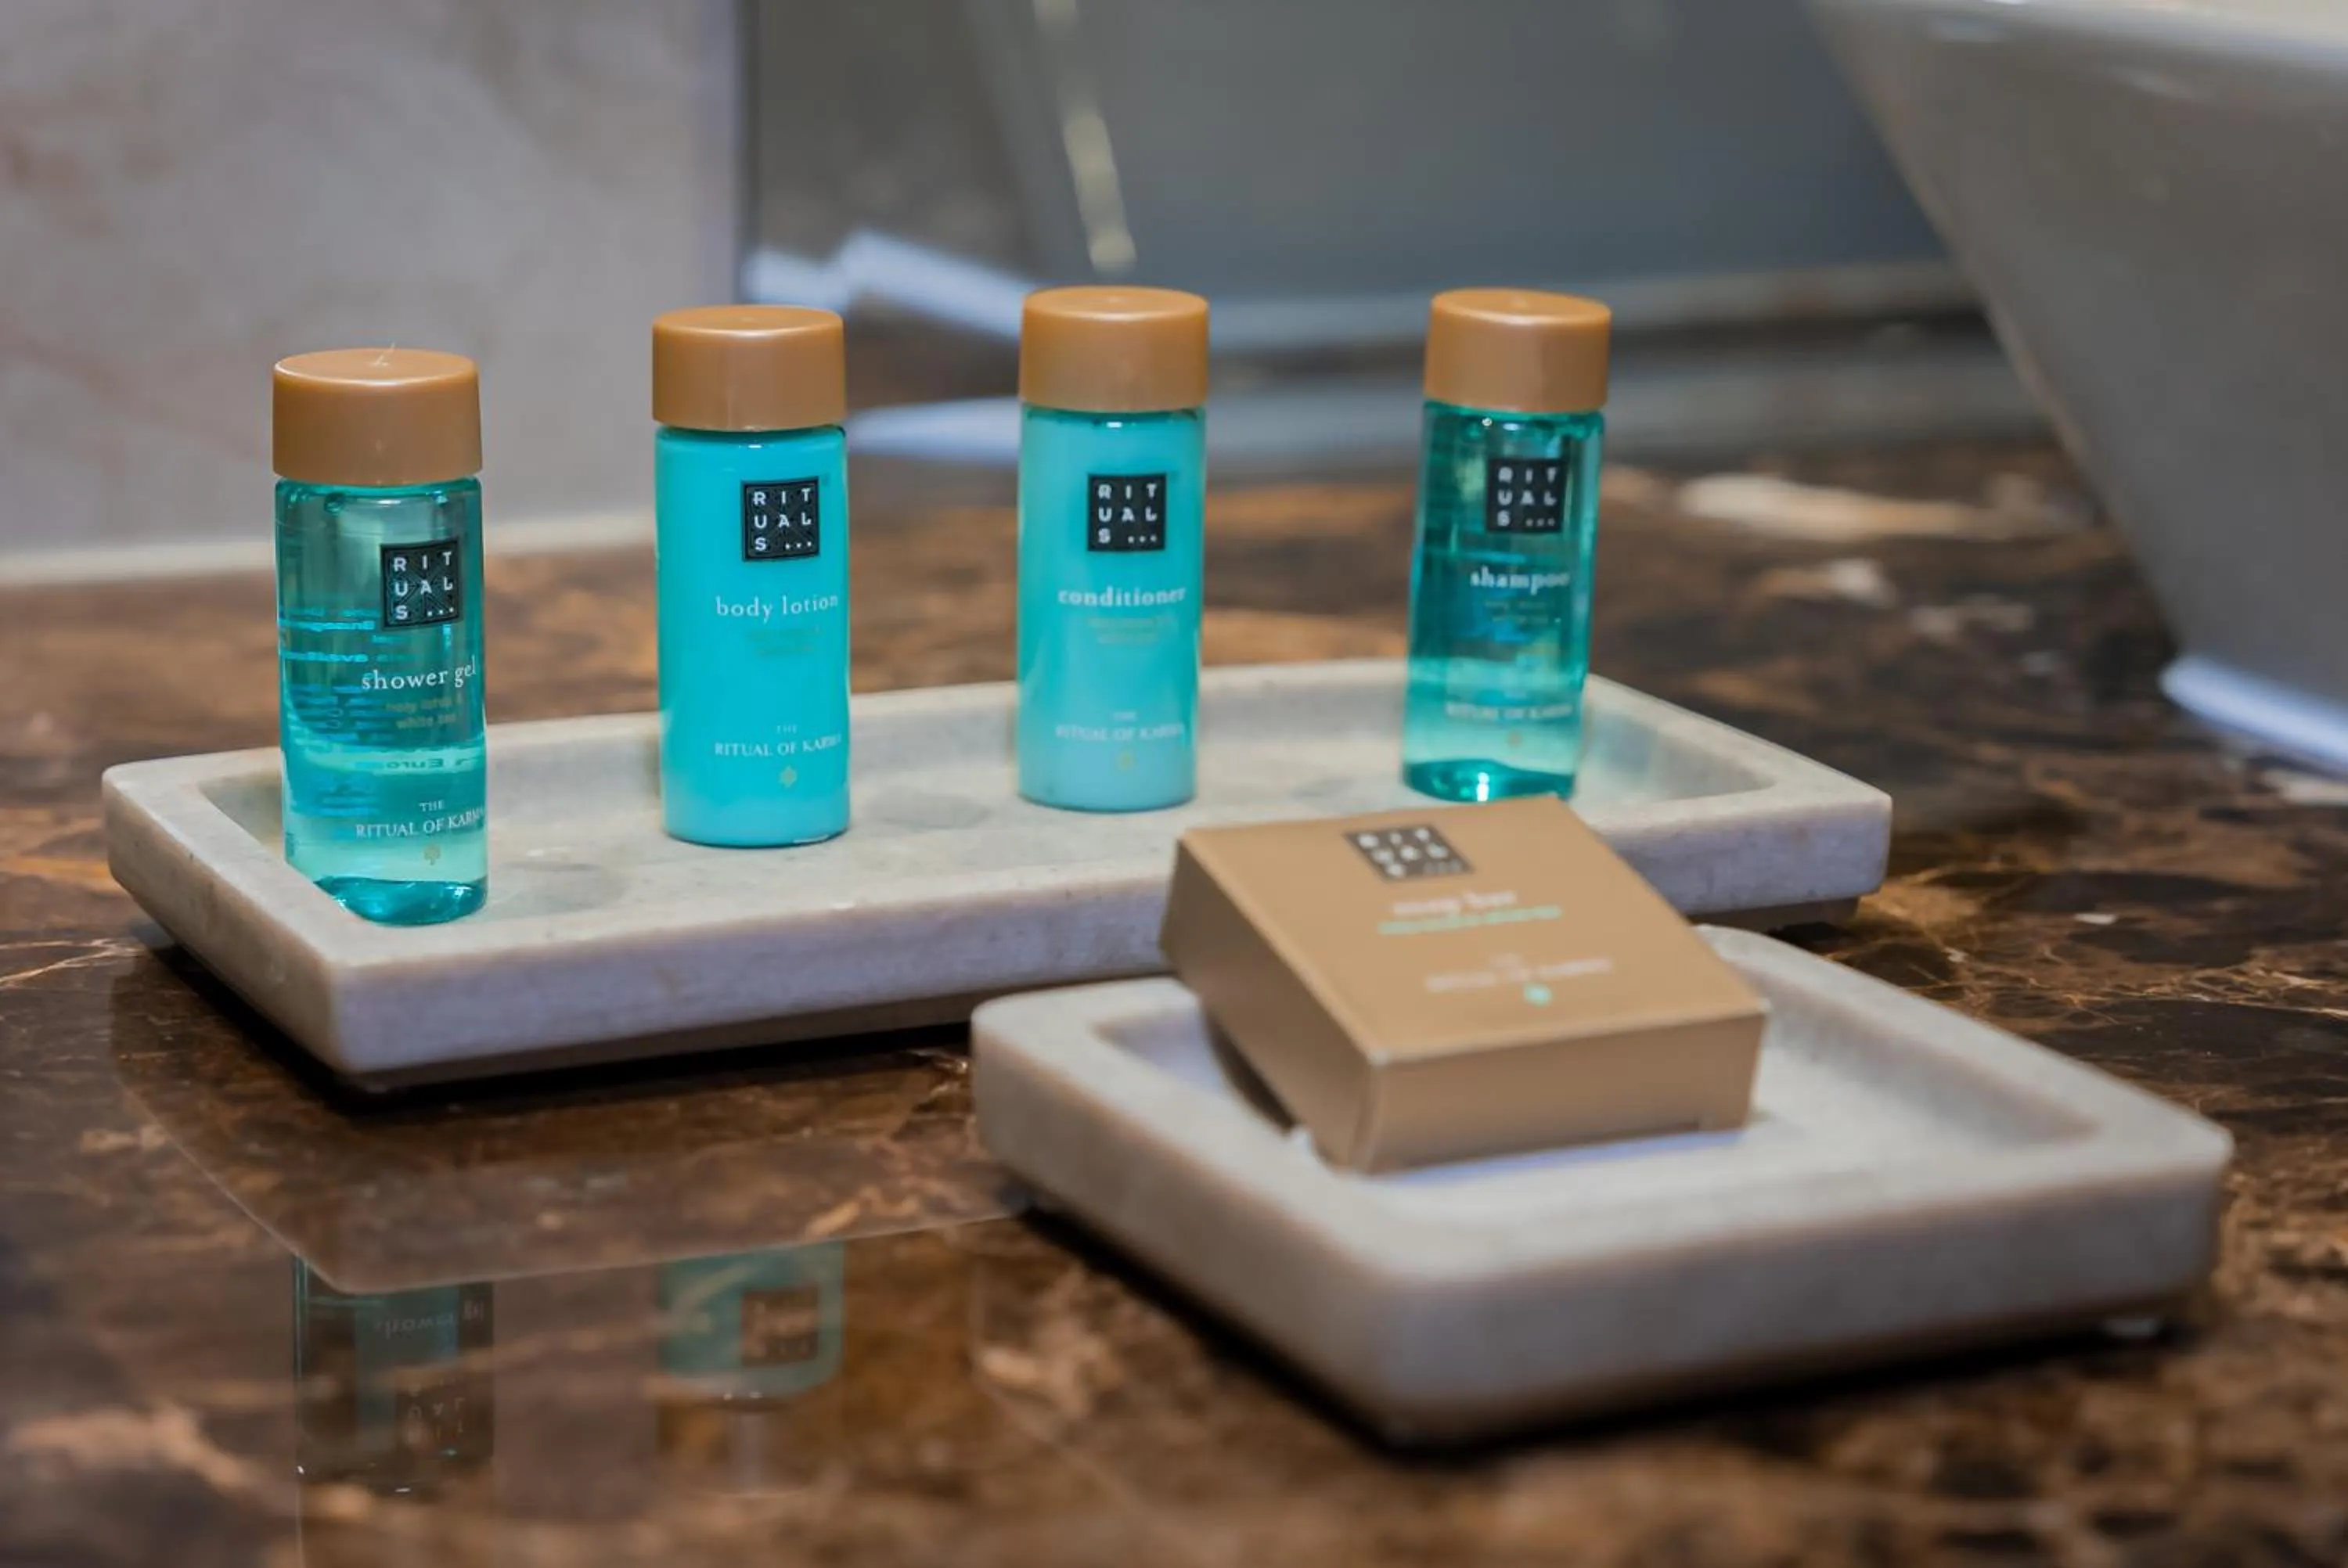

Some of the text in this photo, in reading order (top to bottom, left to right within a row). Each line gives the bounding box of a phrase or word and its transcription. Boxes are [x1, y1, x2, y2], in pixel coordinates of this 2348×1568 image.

[1057, 585, 1187, 607] conditioner
[715, 594, 839, 624] body lotion
[361, 654, 477, 690] shower gel
[714, 741, 772, 757] RITUAL
[777, 742, 798, 756] OF
[419, 800, 445, 812] THE
[355, 822, 420, 840] RITUAL
[423, 818, 445, 835] OF
